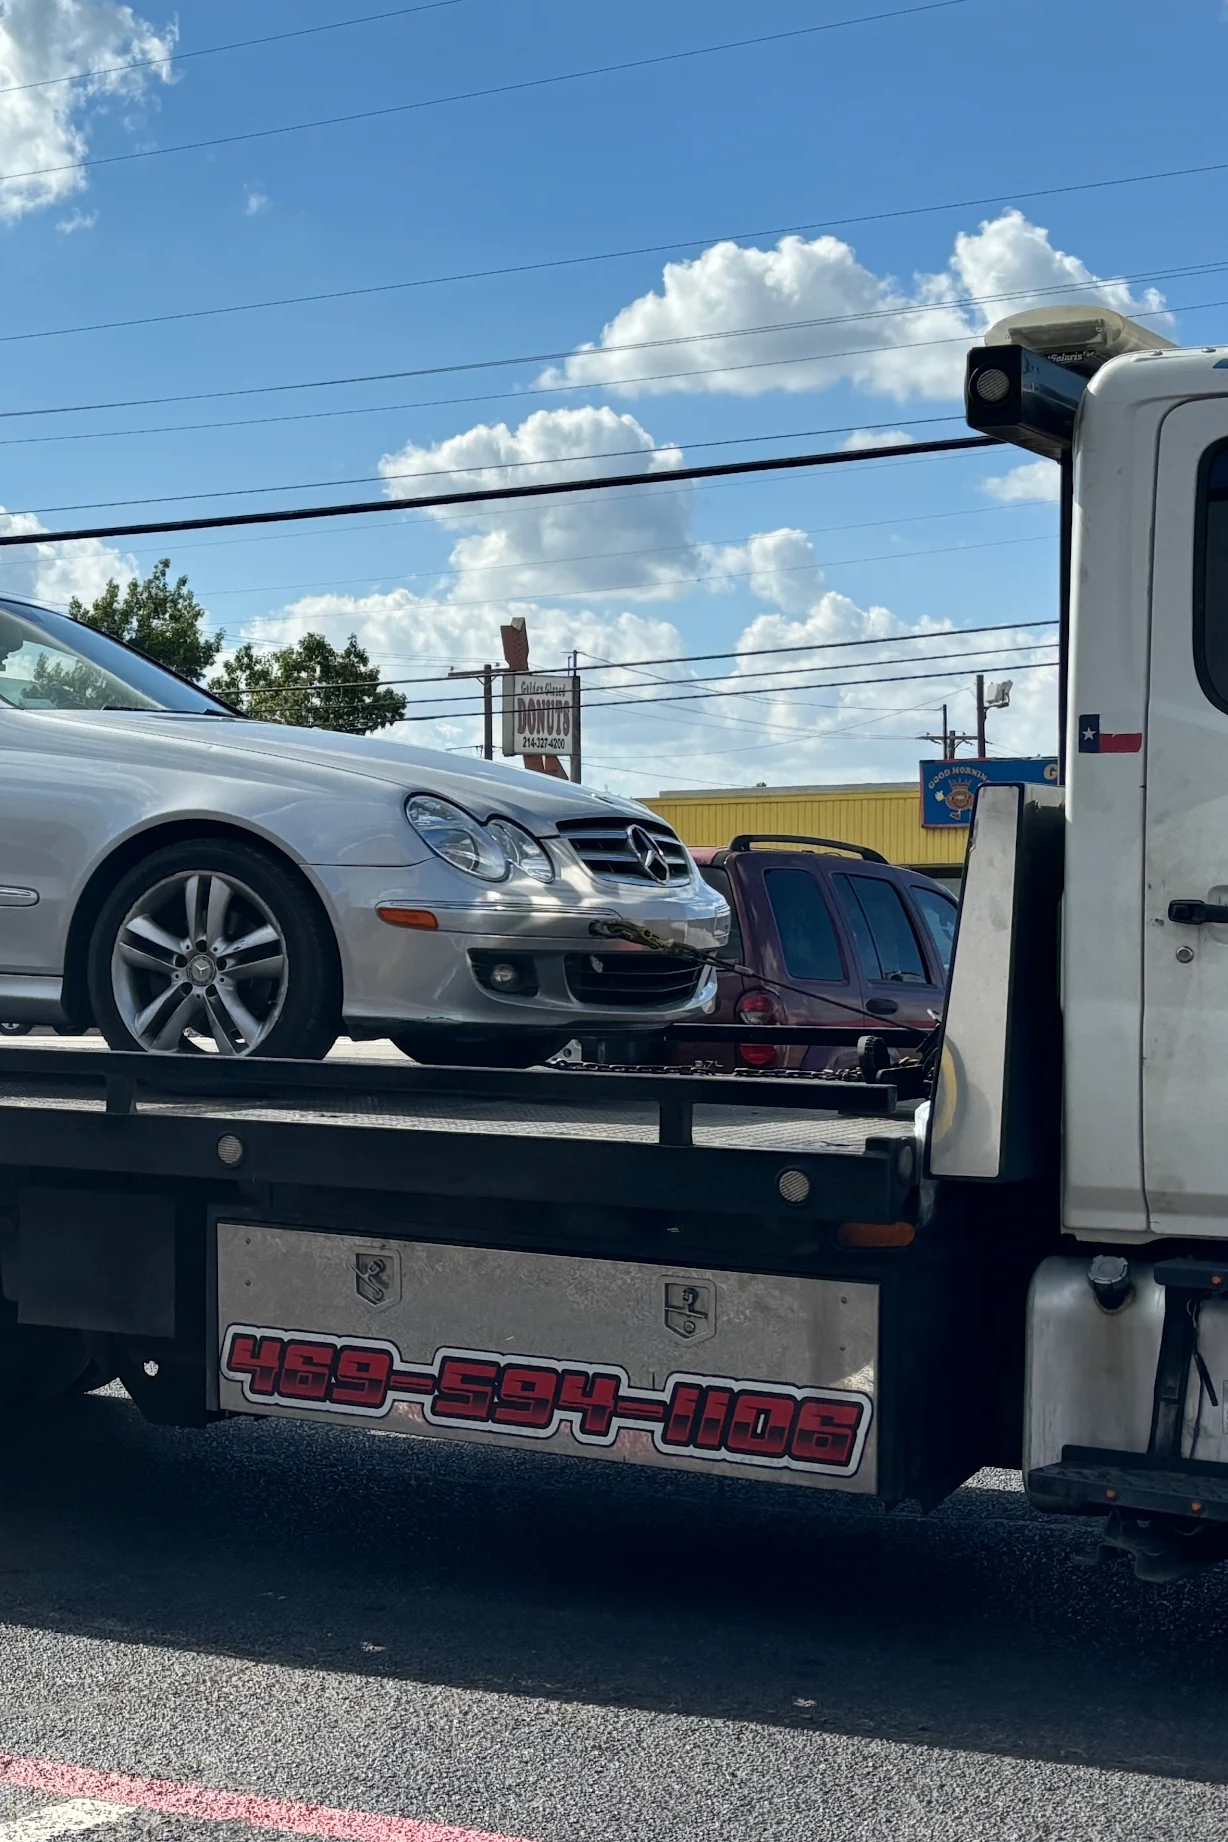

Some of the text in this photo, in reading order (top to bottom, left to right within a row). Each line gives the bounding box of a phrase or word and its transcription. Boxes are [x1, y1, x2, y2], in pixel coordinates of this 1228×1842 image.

[517, 698, 570, 736] DONUTS
[523, 737, 565, 749] 214-327-4200
[928, 767, 988, 789] GOOD MORNIN
[225, 1330, 865, 1469] 469-594-1106
